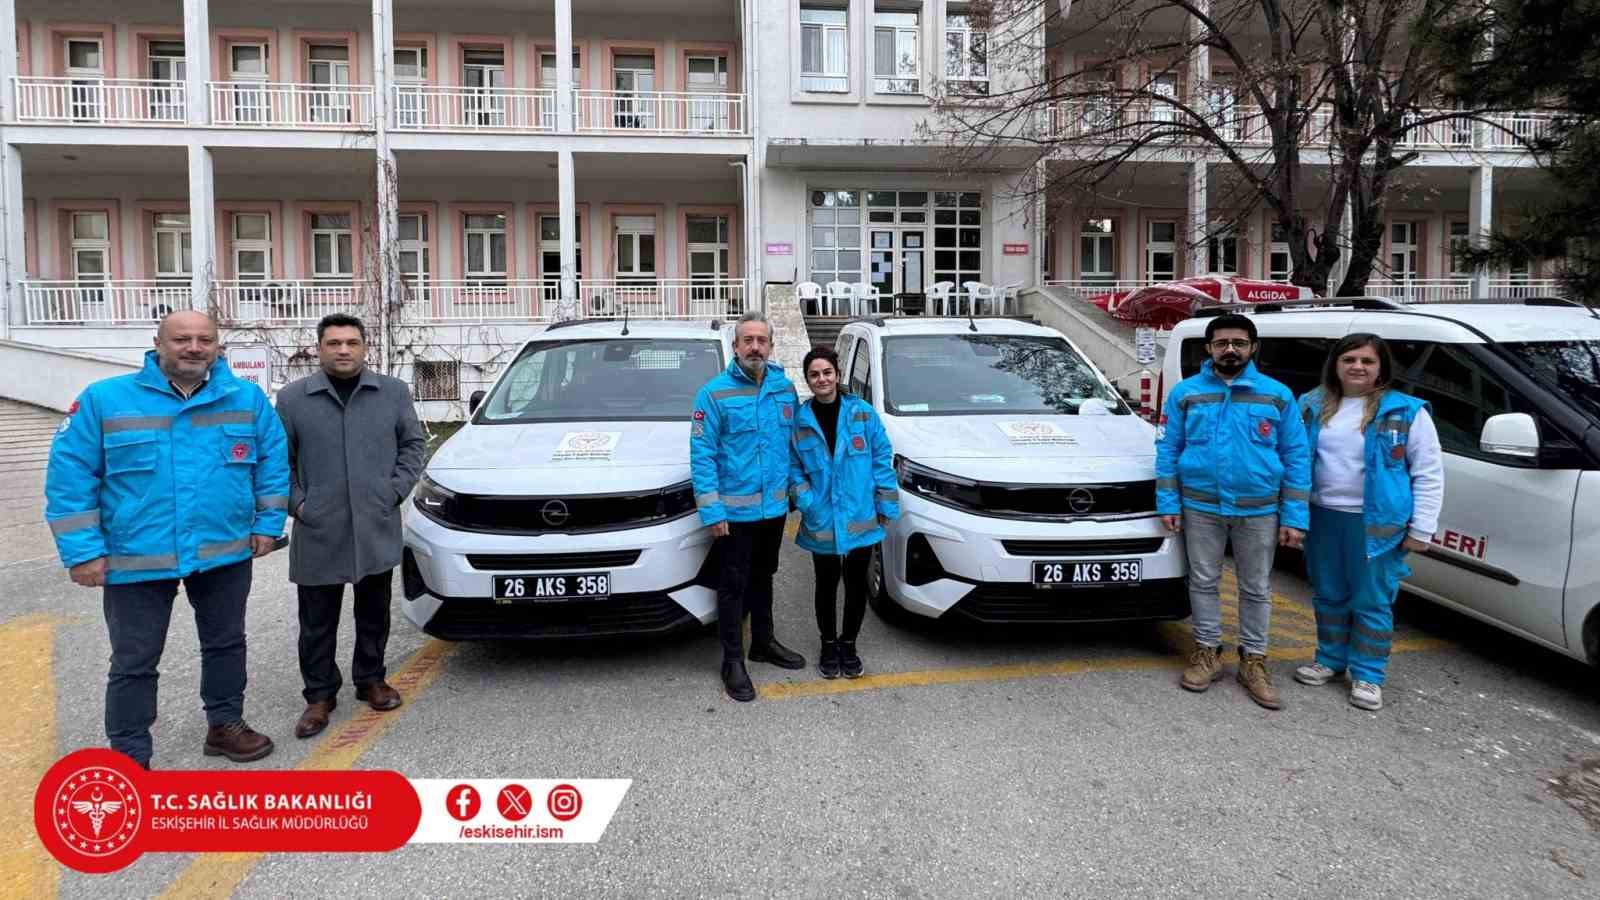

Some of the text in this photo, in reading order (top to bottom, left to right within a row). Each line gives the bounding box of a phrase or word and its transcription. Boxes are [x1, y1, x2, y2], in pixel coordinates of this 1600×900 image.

[1043, 563, 1139, 582] 26 AKS 359
[504, 576, 607, 597] 26 AKS 358
